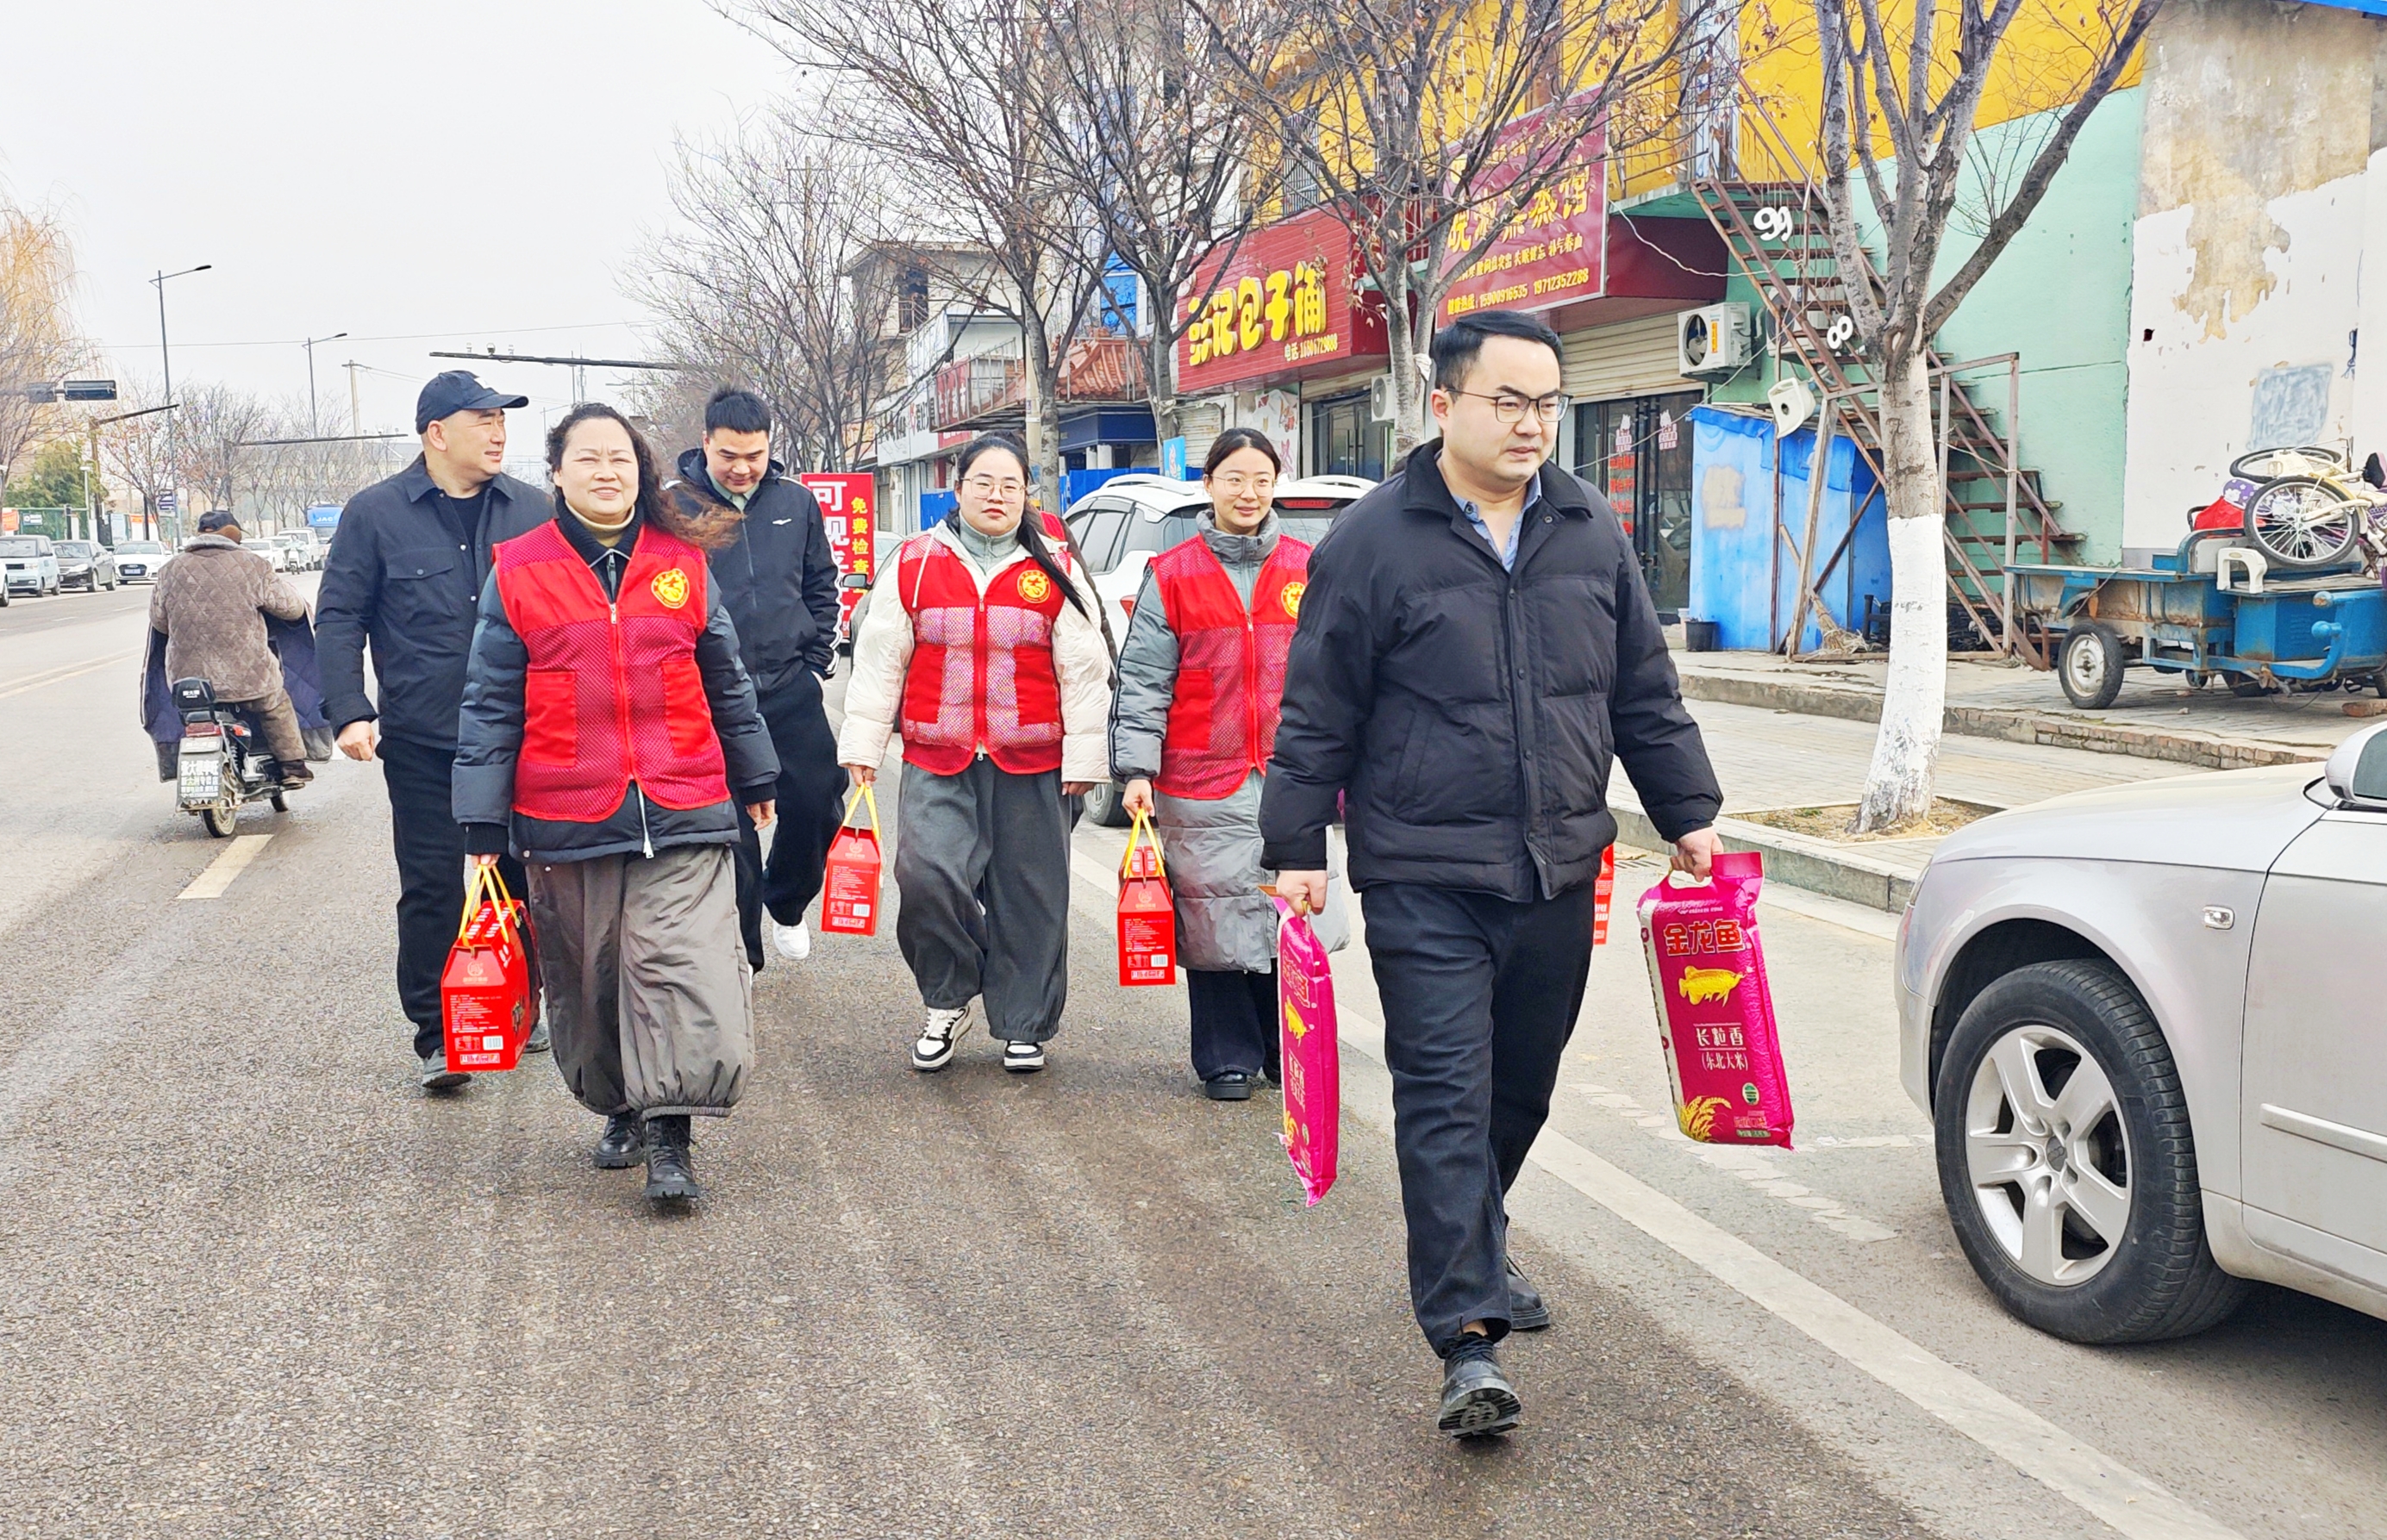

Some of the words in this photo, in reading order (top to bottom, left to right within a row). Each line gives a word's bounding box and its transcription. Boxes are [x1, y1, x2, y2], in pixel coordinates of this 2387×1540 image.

[1663, 919, 1746, 957] 金龙鱼
[1696, 1026, 1744, 1047] 长粒香
